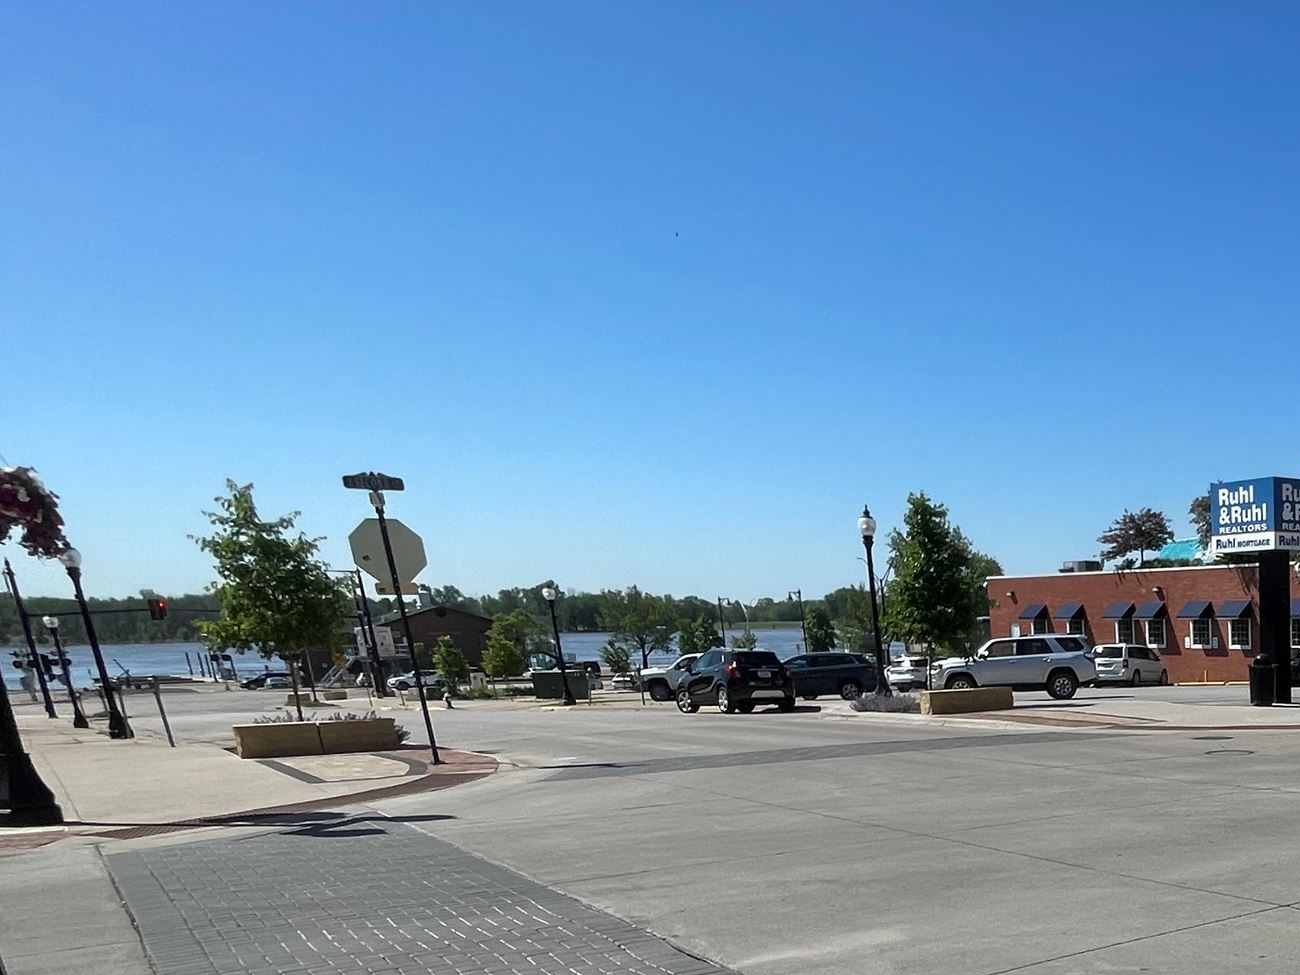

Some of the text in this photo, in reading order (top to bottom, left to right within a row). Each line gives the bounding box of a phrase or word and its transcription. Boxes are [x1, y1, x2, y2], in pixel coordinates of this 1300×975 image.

[1219, 485, 1254, 506] Ruhl
[1219, 503, 1267, 525] &Ruhl
[1219, 523, 1268, 535] REALTORS
[1216, 538, 1236, 550] Ruhl
[1279, 535, 1300, 546] Ruhl
